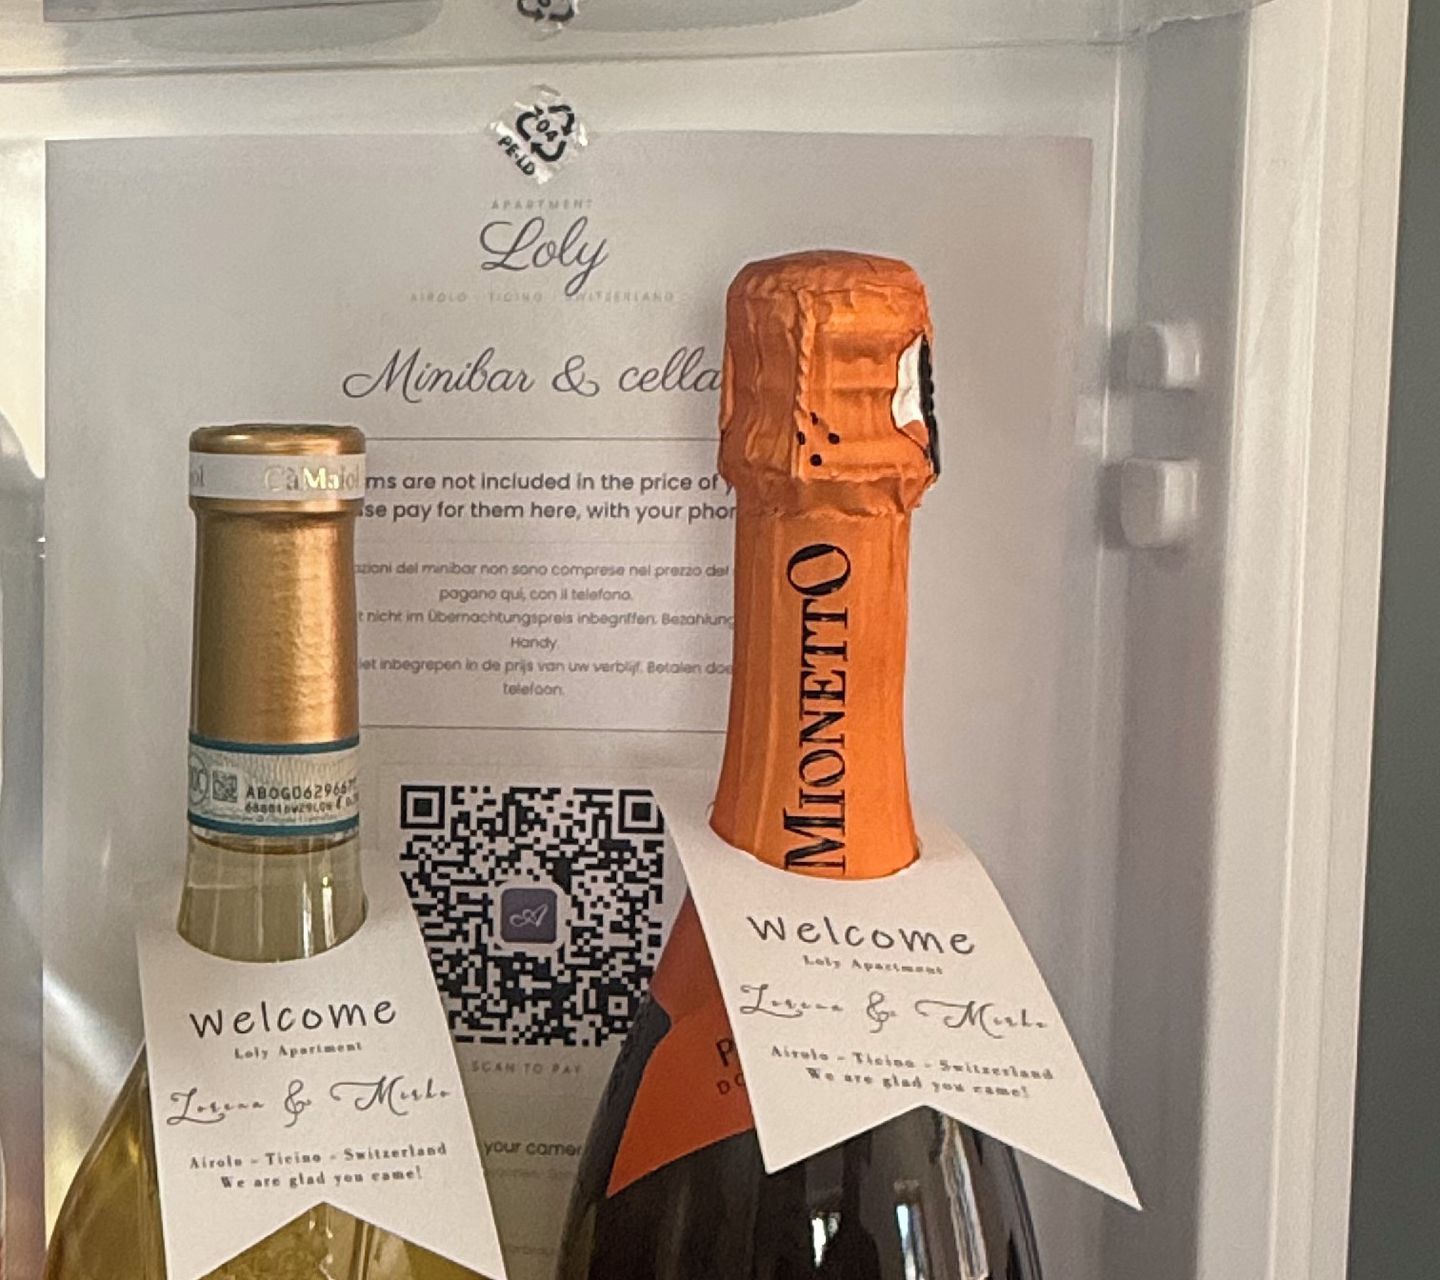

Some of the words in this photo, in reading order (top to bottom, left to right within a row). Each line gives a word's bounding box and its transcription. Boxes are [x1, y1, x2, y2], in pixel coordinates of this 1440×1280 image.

[478, 216, 610, 297] Loly
[341, 347, 536, 404] Minibar
[551, 354, 600, 397] &
[618, 346, 722, 394] cella
[402, 476, 436, 489] are
[442, 475, 475, 489] not
[481, 473, 570, 490] included
[576, 474, 595, 490] in
[601, 474, 634, 490] the
[640, 474, 692, 495] price
[698, 473, 719, 490] of
[392, 504, 431, 522] pay
[437, 501, 465, 517] for
[470, 502, 524, 518] them
[530, 502, 581, 521] here,
[586, 502, 630, 519] with
[636, 505, 683, 524] your
[422, 563, 476, 575] minibar
[783, 543, 851, 875] MIONETTO
[771, 1045, 829, 1061] Airolo
[853, 1051, 916, 1069] Ticino
[939, 1058, 1055, 1081] Switzerland
[806, 1067, 834, 1081] We
[844, 1072, 873, 1084] are
[882, 1073, 923, 1090] glad
[931, 1079, 965, 1094] you
[973, 1085, 1031, 1099] came!
[190, 1156, 243, 1169] Airolo
[265, 1151, 322, 1166] Ticino
[343, 1142, 447, 1161] Switzerland
[482, 1140, 521, 1157] your
[527, 1142, 583, 1157] camer
[220, 1175, 245, 1189] We
[254, 1175, 281, 1188] are
[289, 1172, 325, 1189] glad
[334, 1172, 364, 1186] you
[371, 1165, 423, 1183] came!
